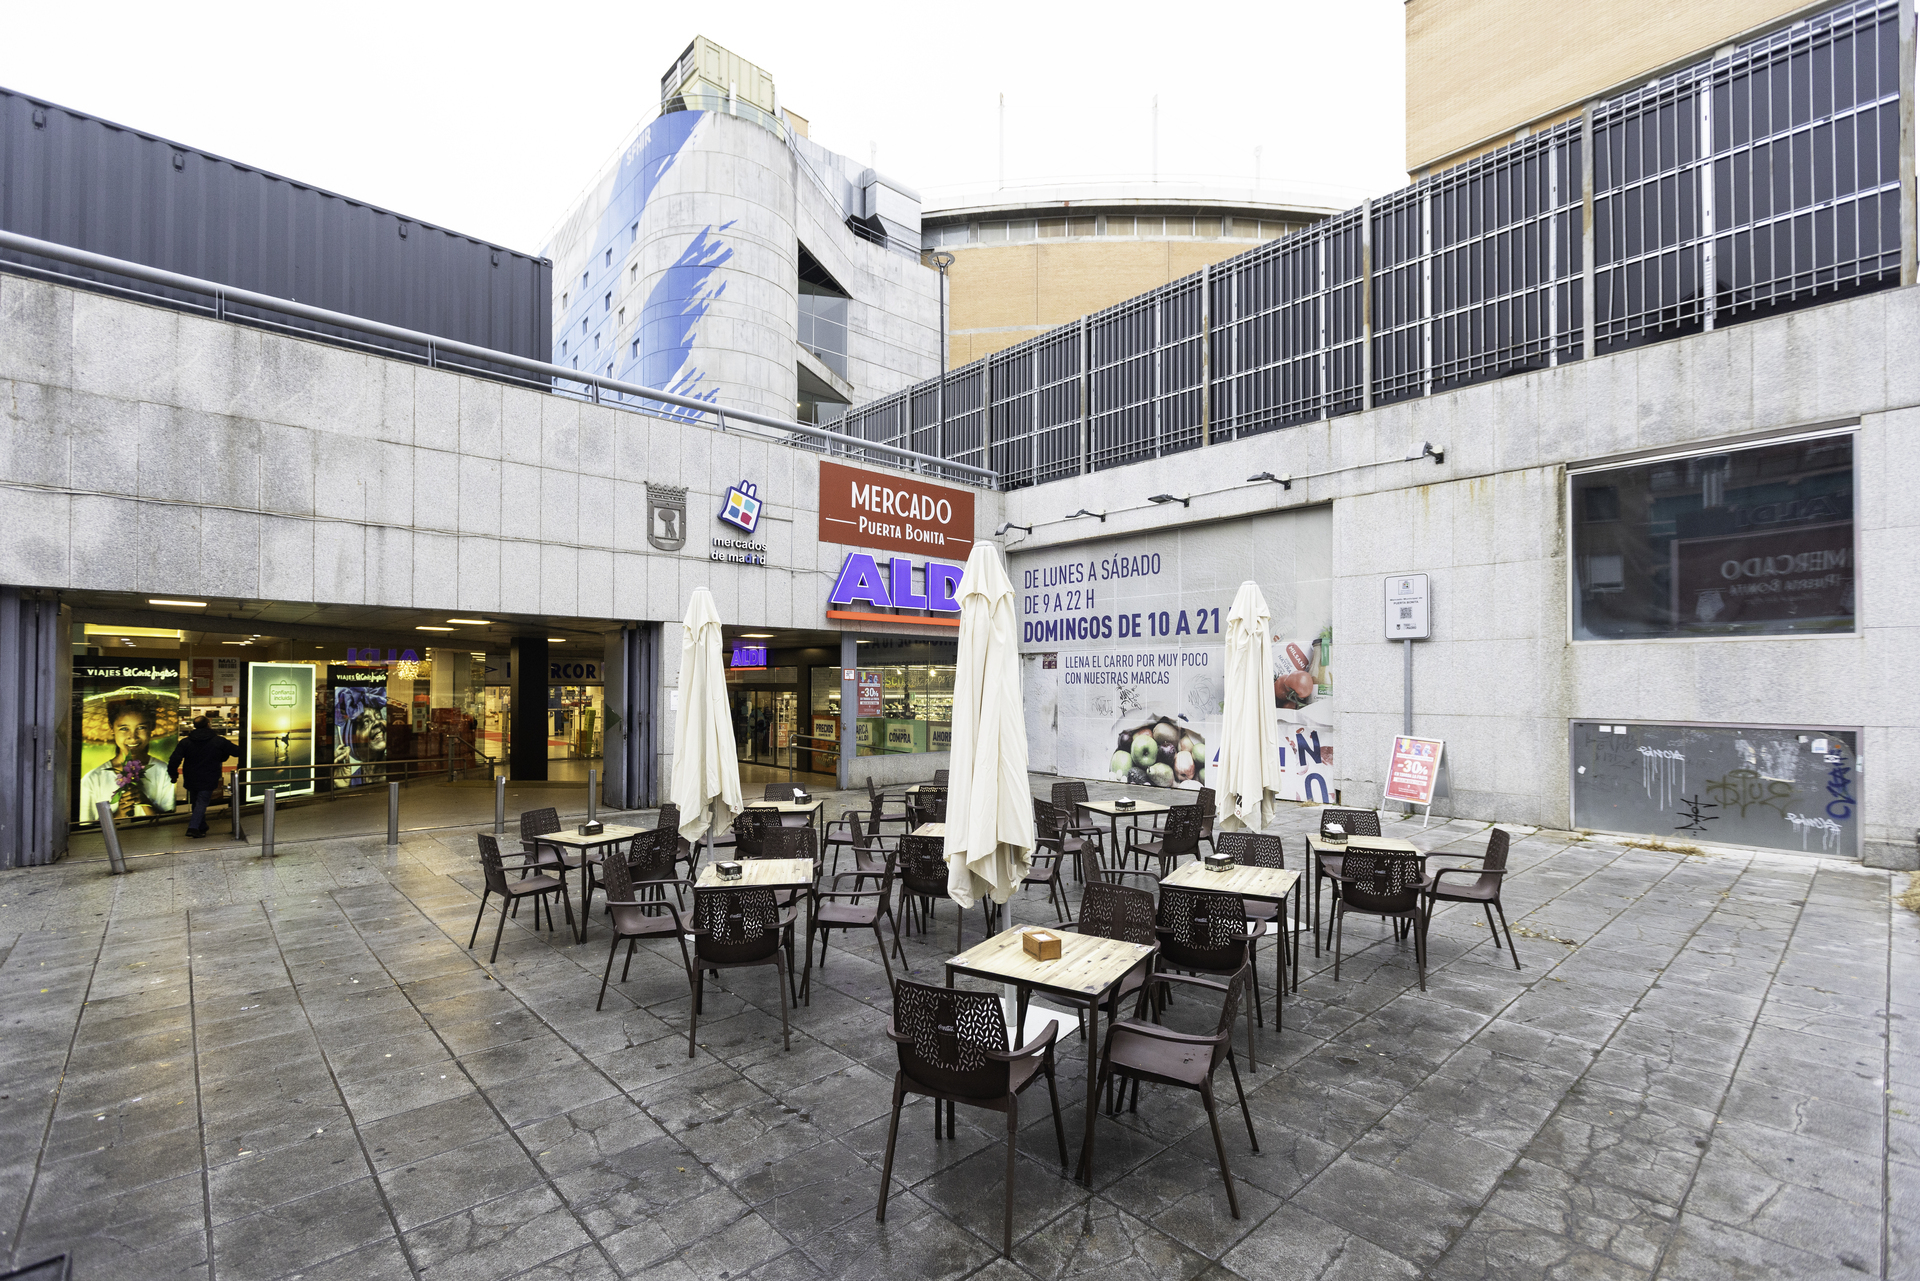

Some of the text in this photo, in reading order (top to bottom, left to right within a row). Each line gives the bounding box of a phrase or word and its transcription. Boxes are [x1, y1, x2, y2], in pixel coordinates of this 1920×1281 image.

[626, 127, 652, 166] SFHIR
[851, 481, 952, 525] MERCADO
[859, 515, 945, 546] PUERTA BONITA
[712, 537, 768, 551] mercados
[711, 550, 766, 566] de madrid
[1024, 553, 1161, 589] DE LUNES A SÁBADO
[827, 552, 965, 613] ALD
[1024, 588, 1095, 615] DE 9 A 22 H
[1023, 607, 1220, 643] DOMINGOS DE 10 A 21
[730, 648, 767, 667] ALDI
[1065, 652, 1209, 668] LLENA EL CARRO POR MUY POCO
[86, 669, 121, 678] VIAJES
[336, 674, 355, 682] VIAJES
[1065, 671, 1170, 685] CON NUESTRAS MARCAS
[860, 688, 879, 697] -30%
[856, 724, 869, 735] ARCA
[888, 732, 912, 744] COMPRA
[1397, 760, 1428, 775] -30%
